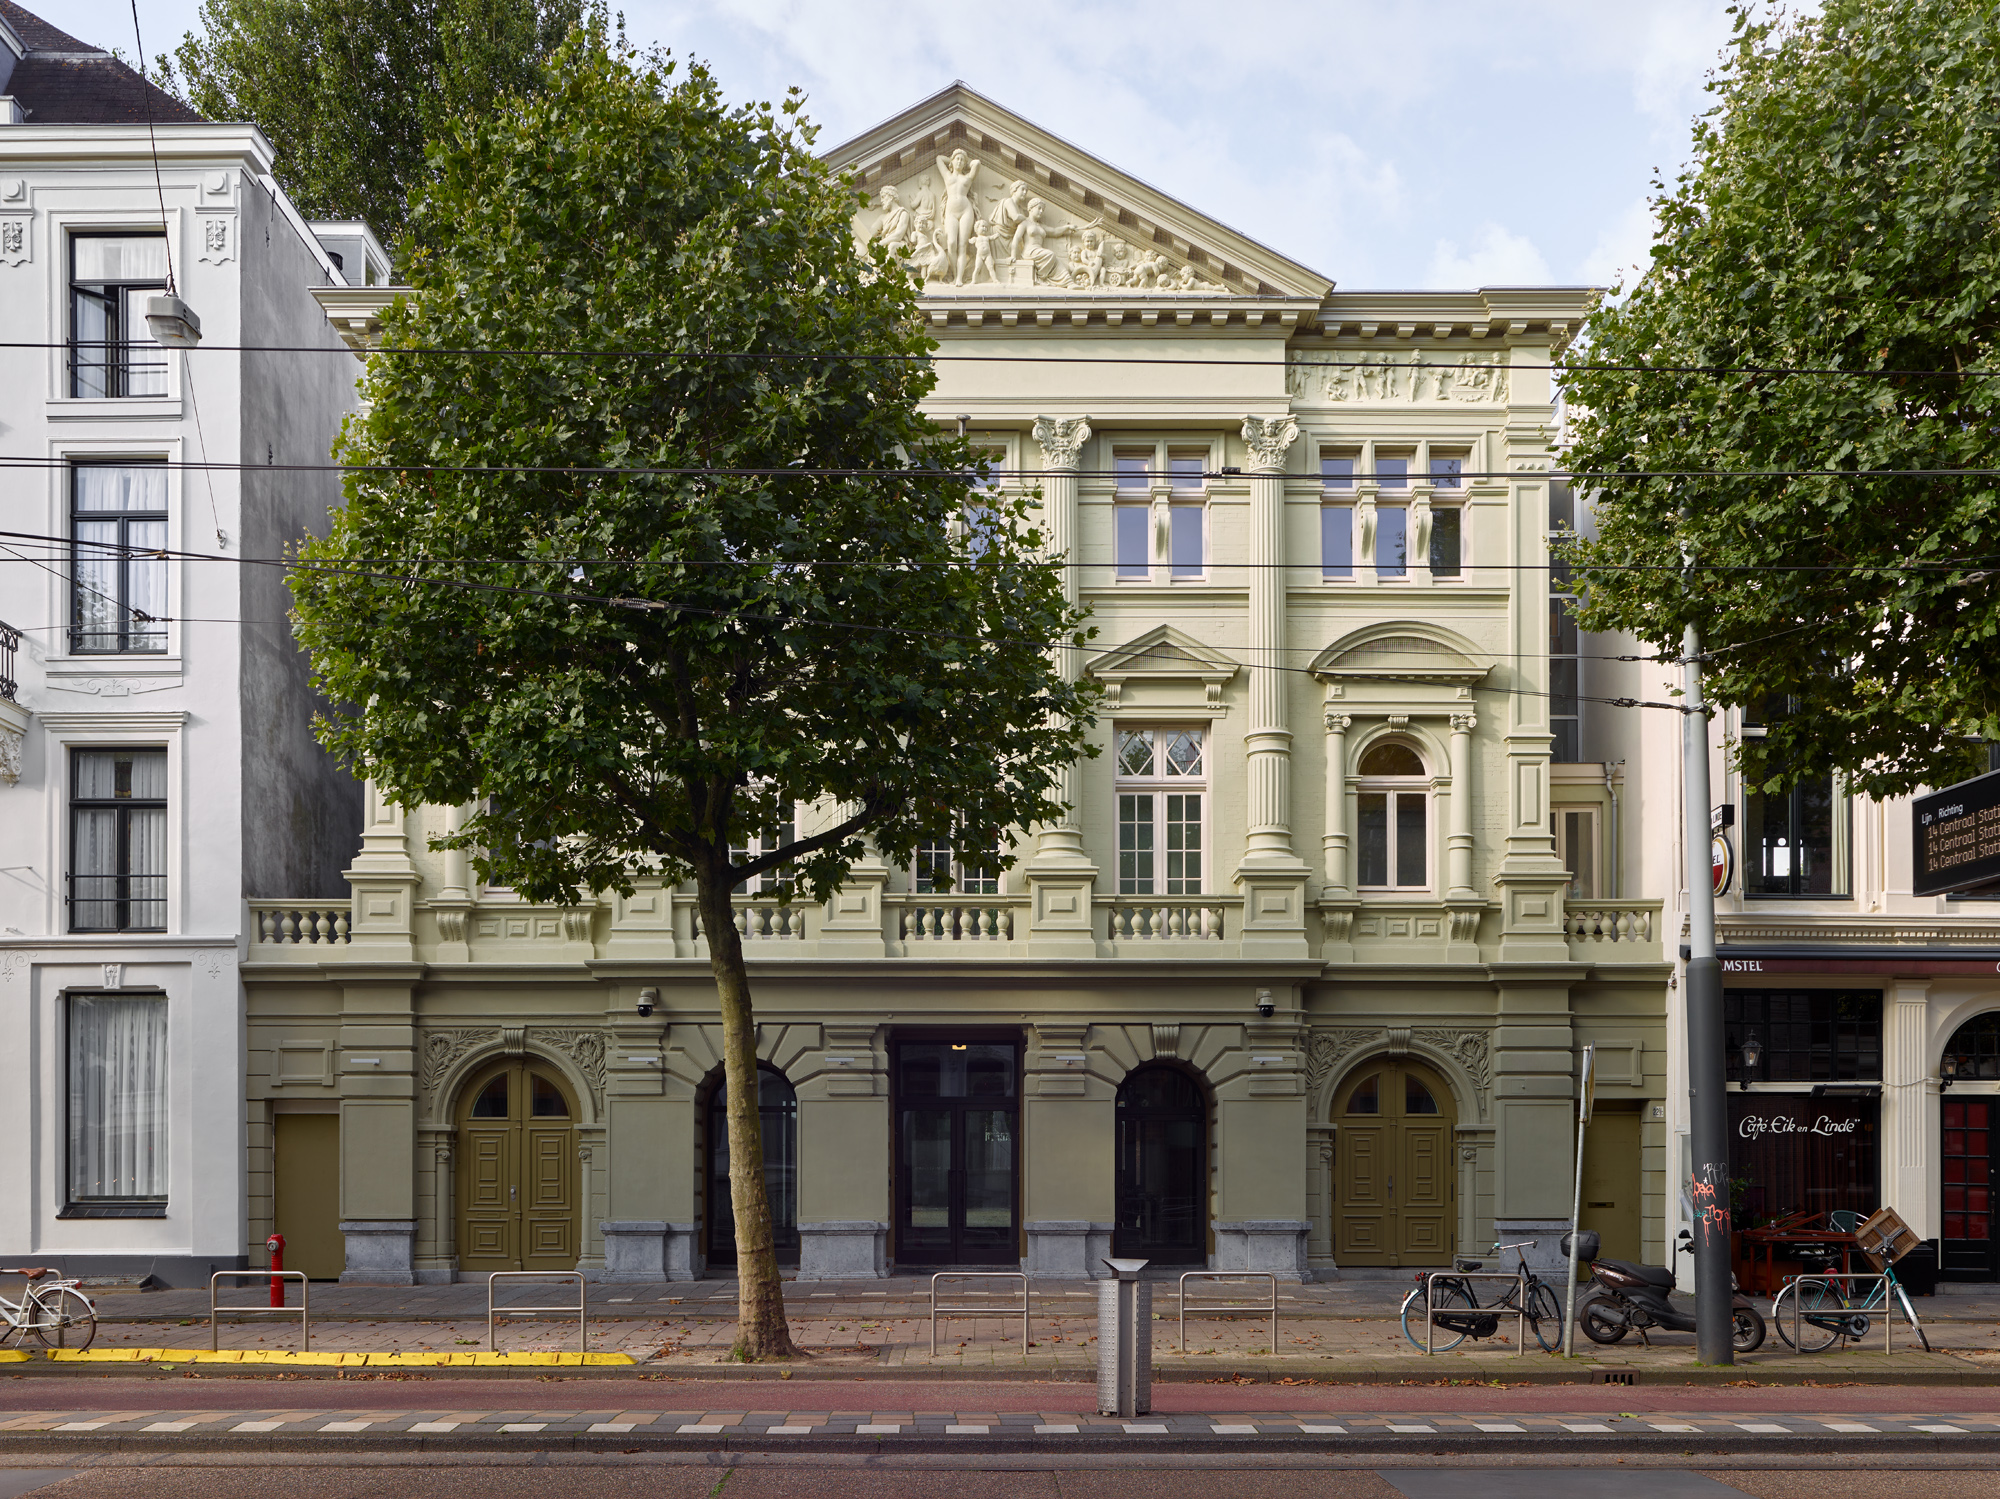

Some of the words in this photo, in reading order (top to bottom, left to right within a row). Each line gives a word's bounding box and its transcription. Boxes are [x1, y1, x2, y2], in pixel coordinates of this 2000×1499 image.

[1922, 813, 1932, 825] Lijn
[1939, 804, 1963, 818] Richting
[1928, 824, 1938, 839] 14
[1939, 812, 1976, 836] Centraal
[1928, 840, 1938, 856] 14
[1939, 828, 1976, 852] Centraal
[1928, 857, 1939, 872] 14
[1940, 845, 1977, 868] Centraal
[1721, 960, 1763, 972] MSTEL
[1739, 1115, 1768, 1140] Café
[1797, 1125, 1808, 1133] en
